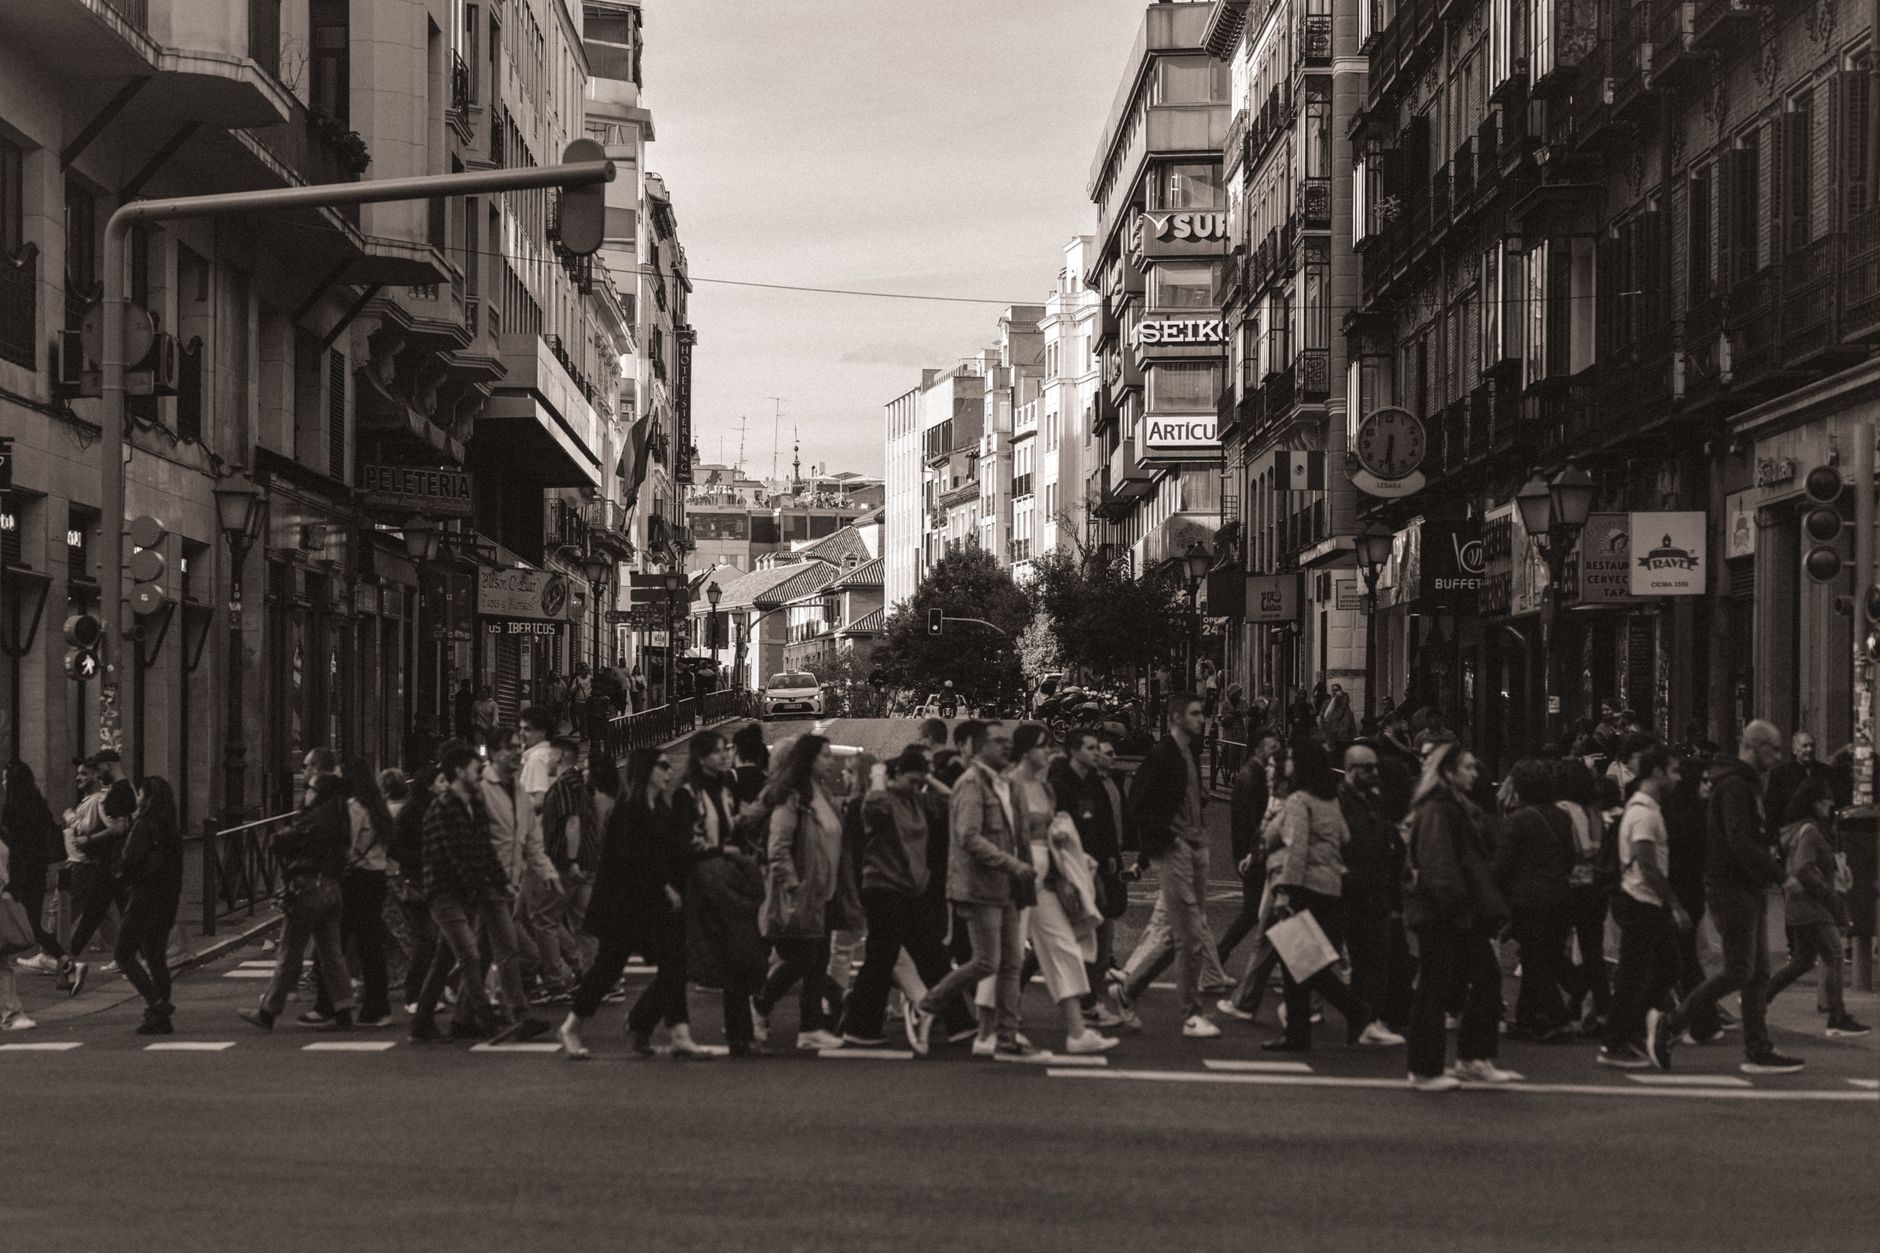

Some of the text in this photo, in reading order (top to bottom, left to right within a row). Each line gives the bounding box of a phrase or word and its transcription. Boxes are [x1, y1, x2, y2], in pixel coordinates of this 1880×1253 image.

[680, 345, 691, 472] HOTEL STERLING
[507, 622, 556, 635] IBERICOS
